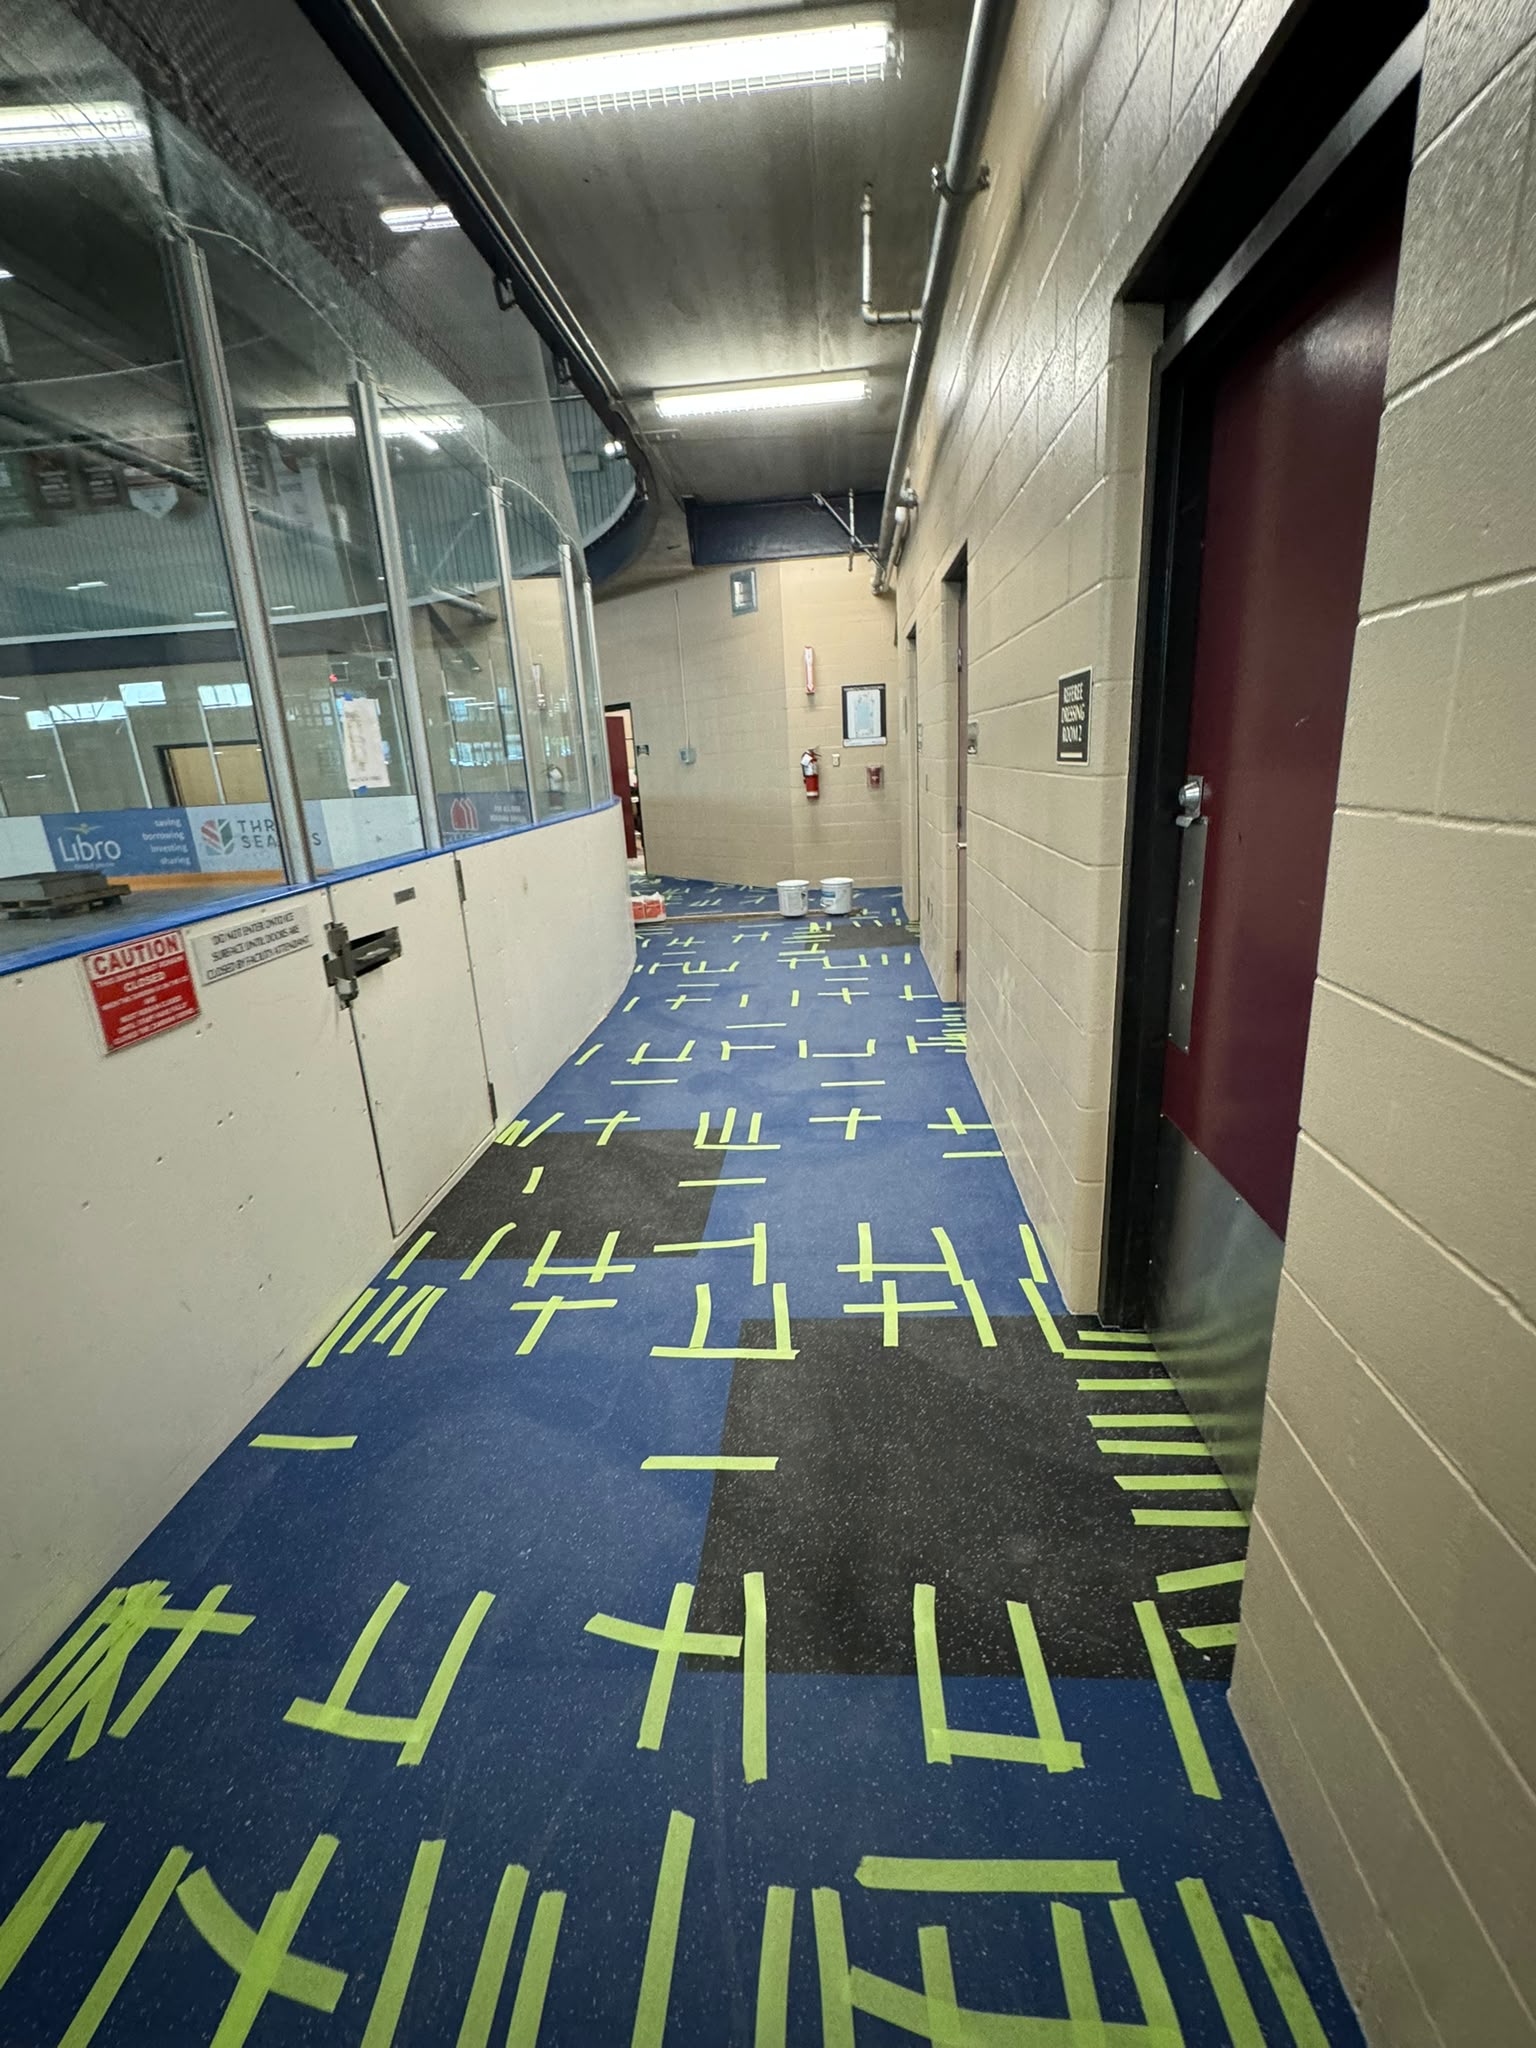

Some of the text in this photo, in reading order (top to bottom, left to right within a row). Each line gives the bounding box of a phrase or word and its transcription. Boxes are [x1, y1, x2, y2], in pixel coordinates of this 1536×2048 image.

[1063, 682, 1083, 704] REFEREE
[1061, 703, 1085, 723] DRESSING
[1062, 725, 1078, 743] ROOM
[154, 818, 182, 828] saving
[236, 819, 276, 833] THR
[142, 832, 185, 842] borrowing
[57, 834, 121, 862] Libro
[151, 843, 188, 853] investing
[160, 856, 191, 866] sharing
[243, 921, 264, 936] ENTER
[93, 936, 178, 975] CAUTION
[206, 962, 235, 980] CLOSED
